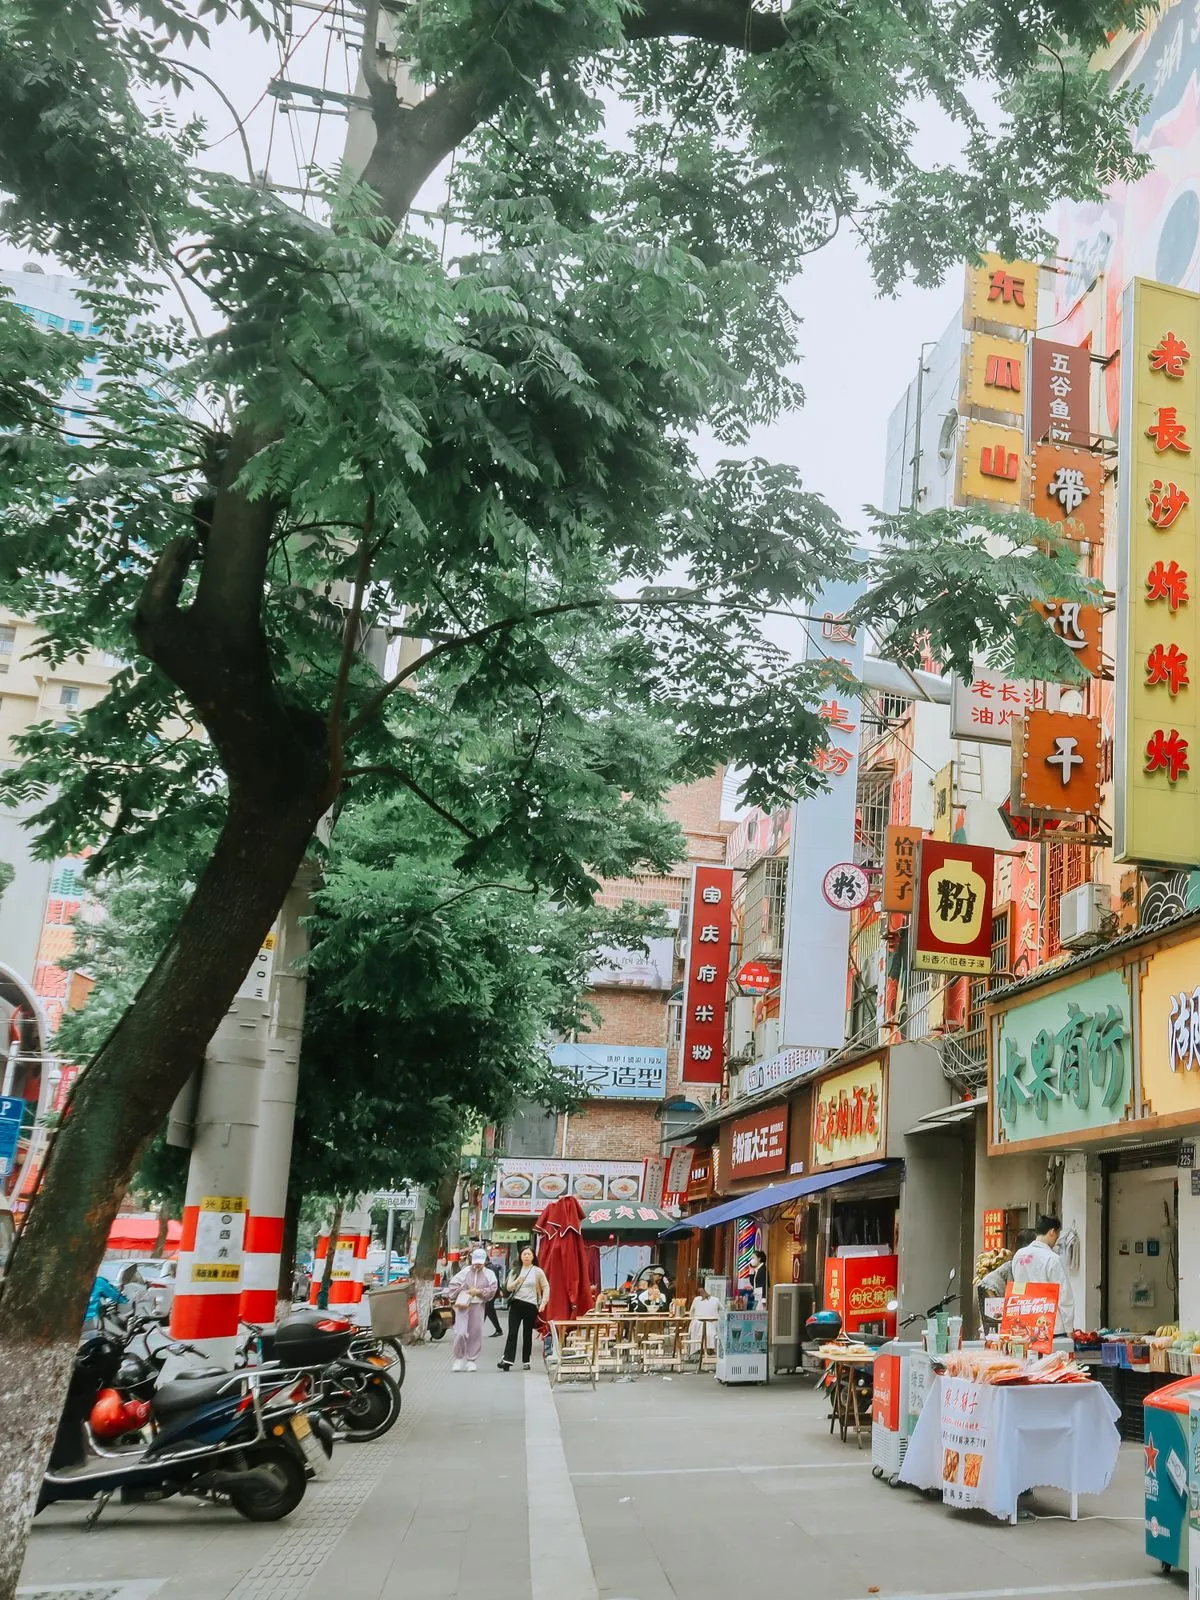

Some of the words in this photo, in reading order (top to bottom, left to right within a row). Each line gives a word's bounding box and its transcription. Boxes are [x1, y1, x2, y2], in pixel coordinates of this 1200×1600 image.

[971, 680, 1044, 704] 老长沙
[832, 872, 861, 901] 粉
[936, 879, 977, 924] 粉
[692, 886, 723, 1061] 宝庆府米粉
[922, 954, 985, 968] 粉香不怕巷子深
[996, 1002, 1131, 1123] 水果商行
[736, 1127, 769, 1164] 粉面大王
[1180, 1154, 1191, 1165] 225
[588, 1205, 674, 1224] 农夫山
